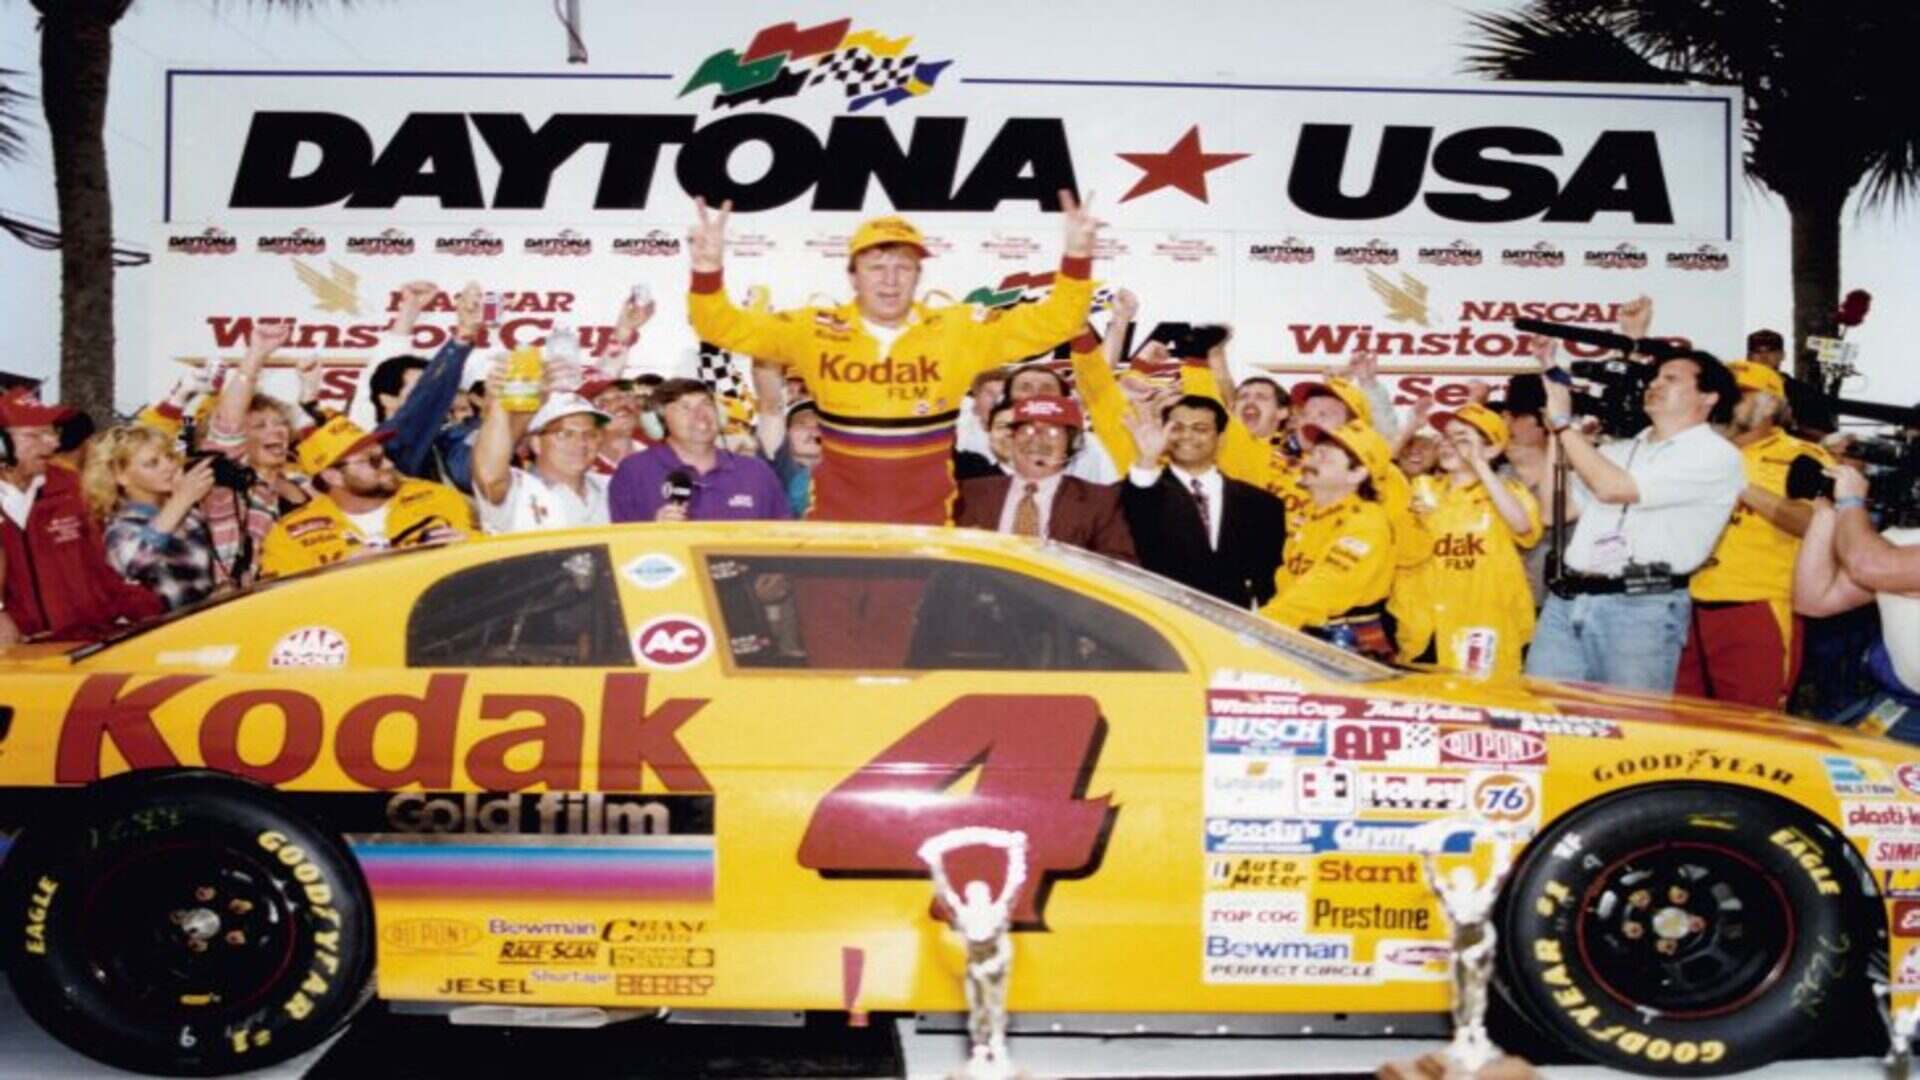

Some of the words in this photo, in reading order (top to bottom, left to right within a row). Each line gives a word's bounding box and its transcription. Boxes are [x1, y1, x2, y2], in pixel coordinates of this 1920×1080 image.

[229, 112, 1081, 212] DAYTONA
[1287, 123, 1674, 224] USA
[168, 237, 237, 248] DAYTONA
[257, 237, 326, 248] DAYTONA
[347, 237, 415, 248] DAYTONA
[436, 237, 503, 248] DAYTONA
[524, 238, 592, 248] DAYTONA
[613, 238, 681, 249] DAYTONA
[1250, 245, 1315, 255] DAYTONA
[1335, 246, 1398, 257] DAYTONA
[1418, 248, 1482, 258] DAYTONA
[1502, 249, 1566, 259] DAYTONA
[1585, 251, 1648, 261] DAYTONA
[1666, 252, 1729, 263] DAYTONA
[819, 352, 941, 384] Kodak
[1433, 532, 1486, 557] dak
[643, 628, 700, 656] AC
[55, 673, 714, 790] Kodak
[1333, 724, 1402, 760] AP
[1486, 788, 1524, 810] 76
[386, 792, 521, 835] Gold
[536, 792, 670, 835] film
[798, 694, 1118, 931] 4
[1237, 859, 1296, 872] Auto
[1768, 826, 1842, 896] EAGLE
[1318, 859, 1418, 883] Stant
[1229, 873, 1307, 888] Meter
[26, 875, 59, 955] EAGLE
[1211, 910, 1251, 923] TOP
[1257, 910, 1299, 923] COG
[1313, 899, 1430, 931] Prestone
[489, 919, 597, 934] Bowman
[1206, 935, 1349, 958] Bowman
[1211, 964, 1299, 977] PERFECT
[1304, 964, 1376, 978] CIRCLE
[438, 978, 534, 995] JESEL
